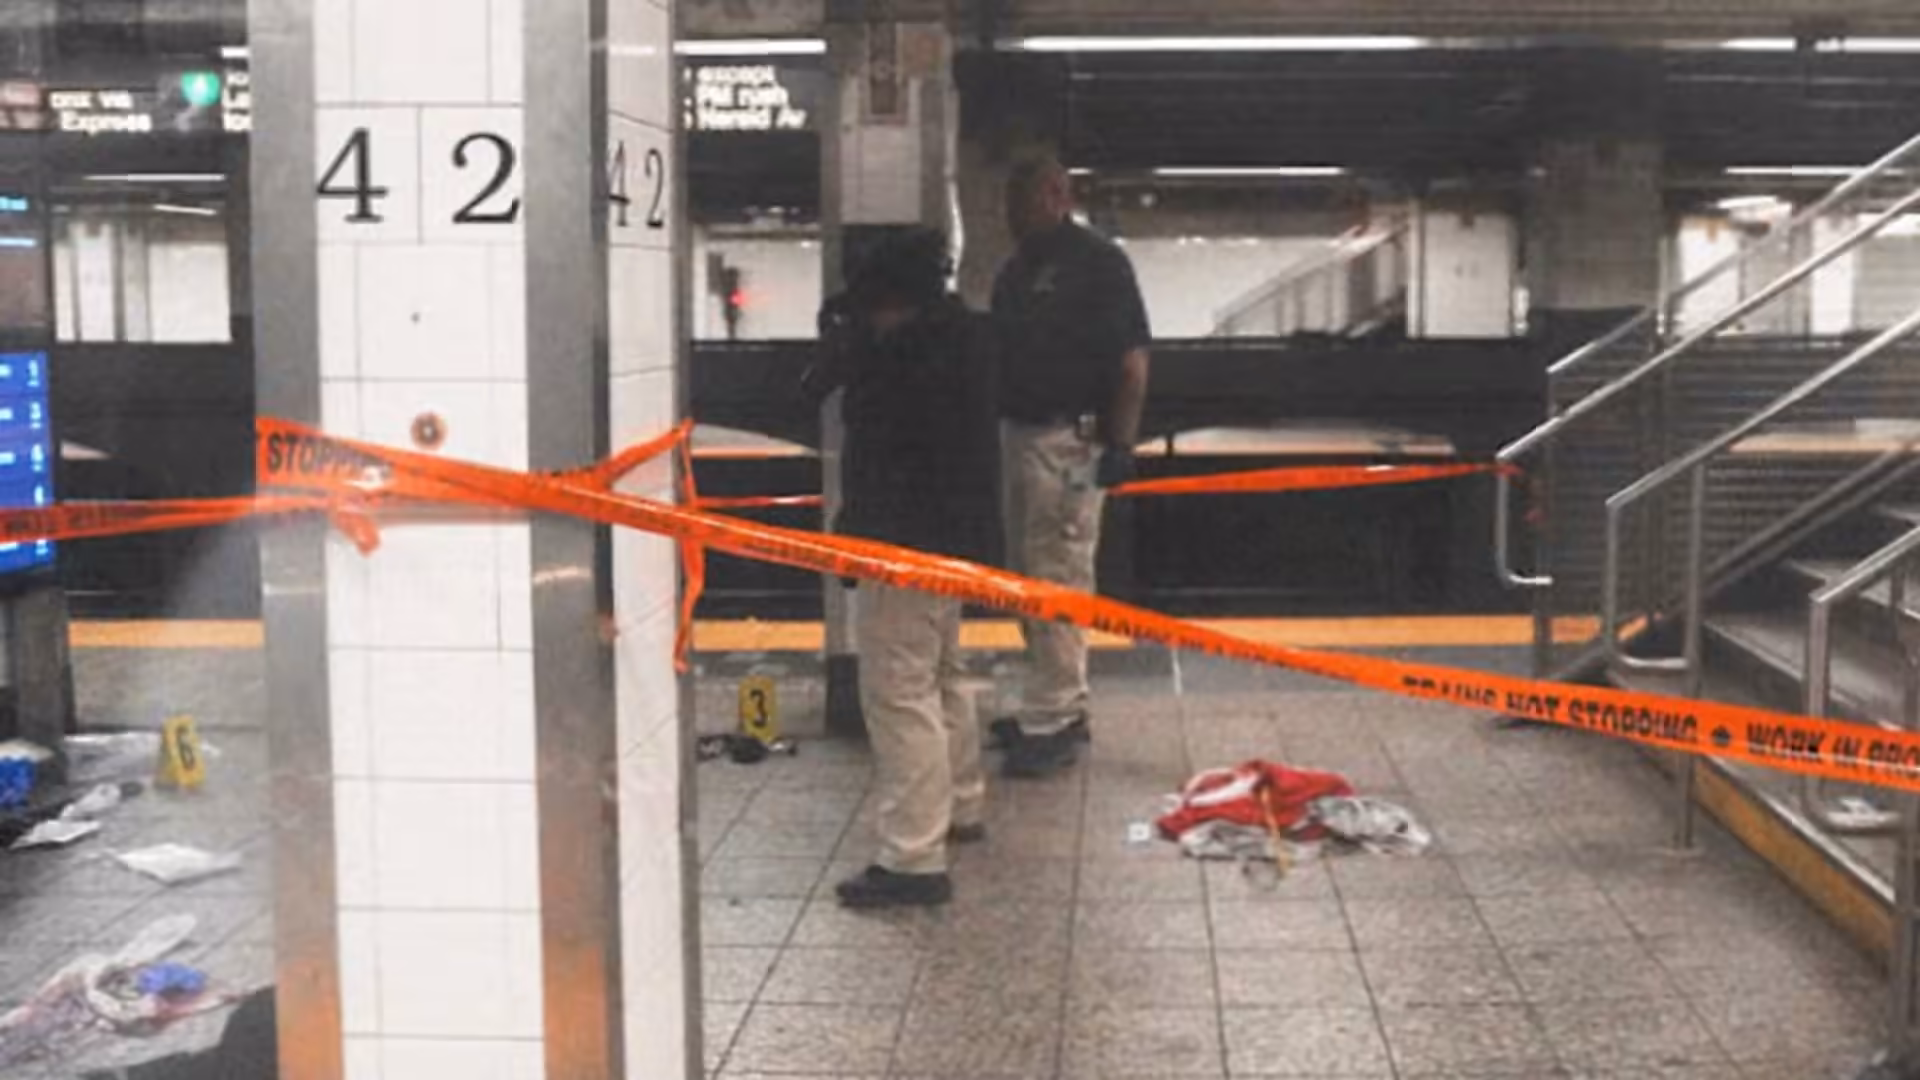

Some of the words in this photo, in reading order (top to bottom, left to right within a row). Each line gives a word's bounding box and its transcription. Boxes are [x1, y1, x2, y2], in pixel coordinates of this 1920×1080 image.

[61, 111, 151, 135] Express
[267, 431, 394, 482] STOPP
[749, 688, 768, 729] 3
[175, 725, 196, 772] 6
[1568, 698, 1699, 743] STOPPING
[1746, 723, 1826, 763] WORK
[1832, 736, 1862, 768] IN
